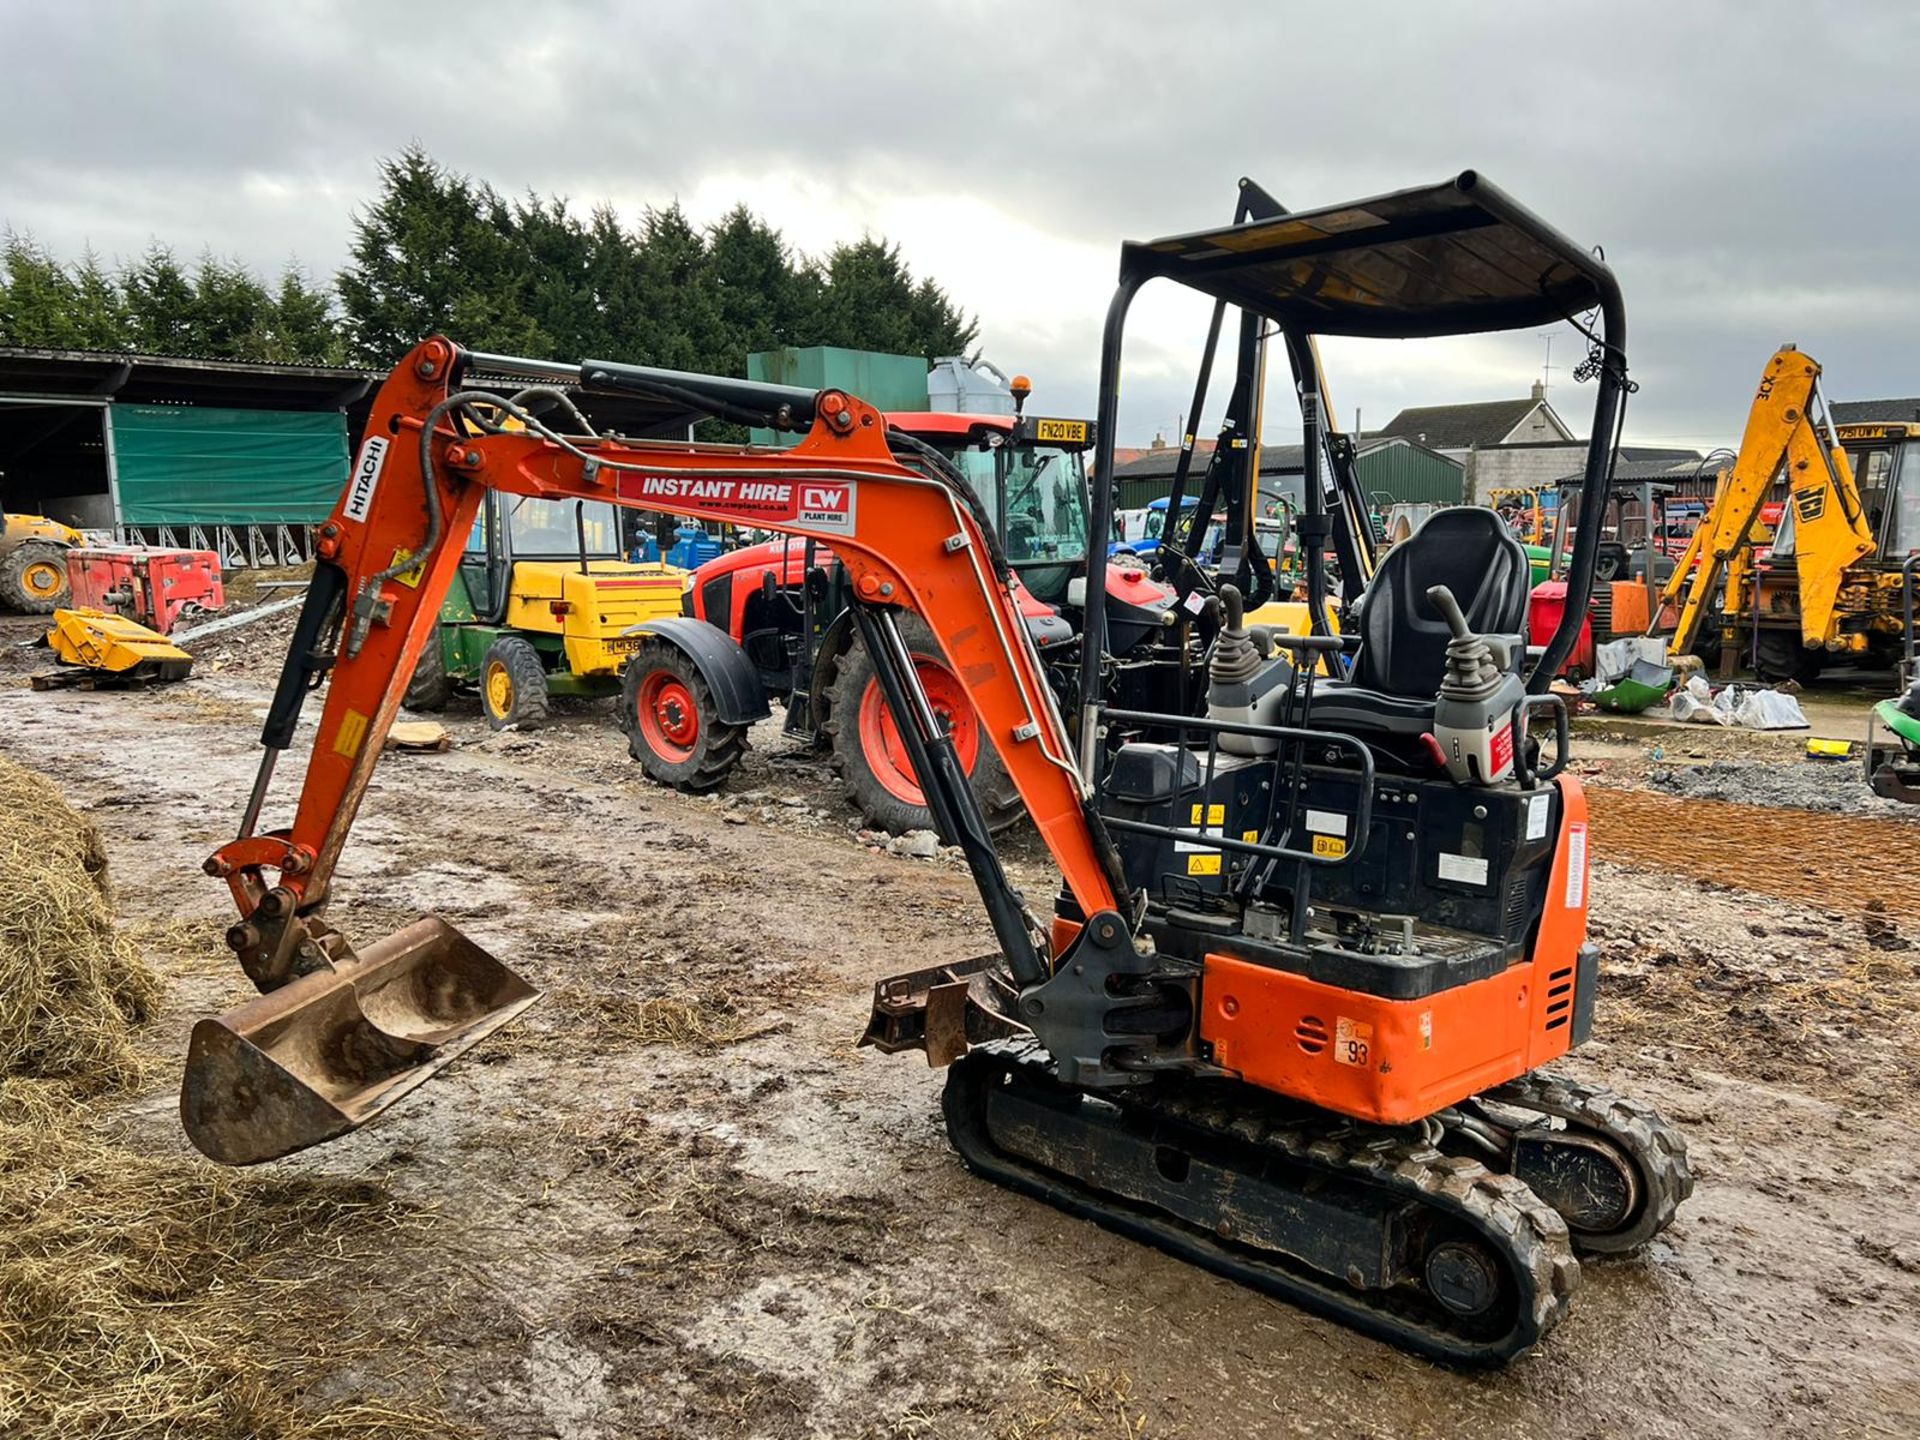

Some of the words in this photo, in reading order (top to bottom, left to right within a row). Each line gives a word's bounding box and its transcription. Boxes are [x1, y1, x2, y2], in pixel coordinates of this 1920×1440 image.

[1757, 376, 1776, 401] 3CX
[1041, 423, 1065, 439] FN20
[1066, 424, 1082, 439] VBE
[350, 440, 382, 515] HITACHI
[642, 477, 736, 498] INSTANT
[739, 482, 792, 501] HIRE
[698, 501, 789, 512] www.cwplant.co.uk
[804, 488, 842, 510] CW
[1795, 486, 1825, 519] JCB
[804, 512, 826, 521] PLANT
[827, 513, 842, 522] HIRE
[1348, 1040, 1368, 1066] 93
